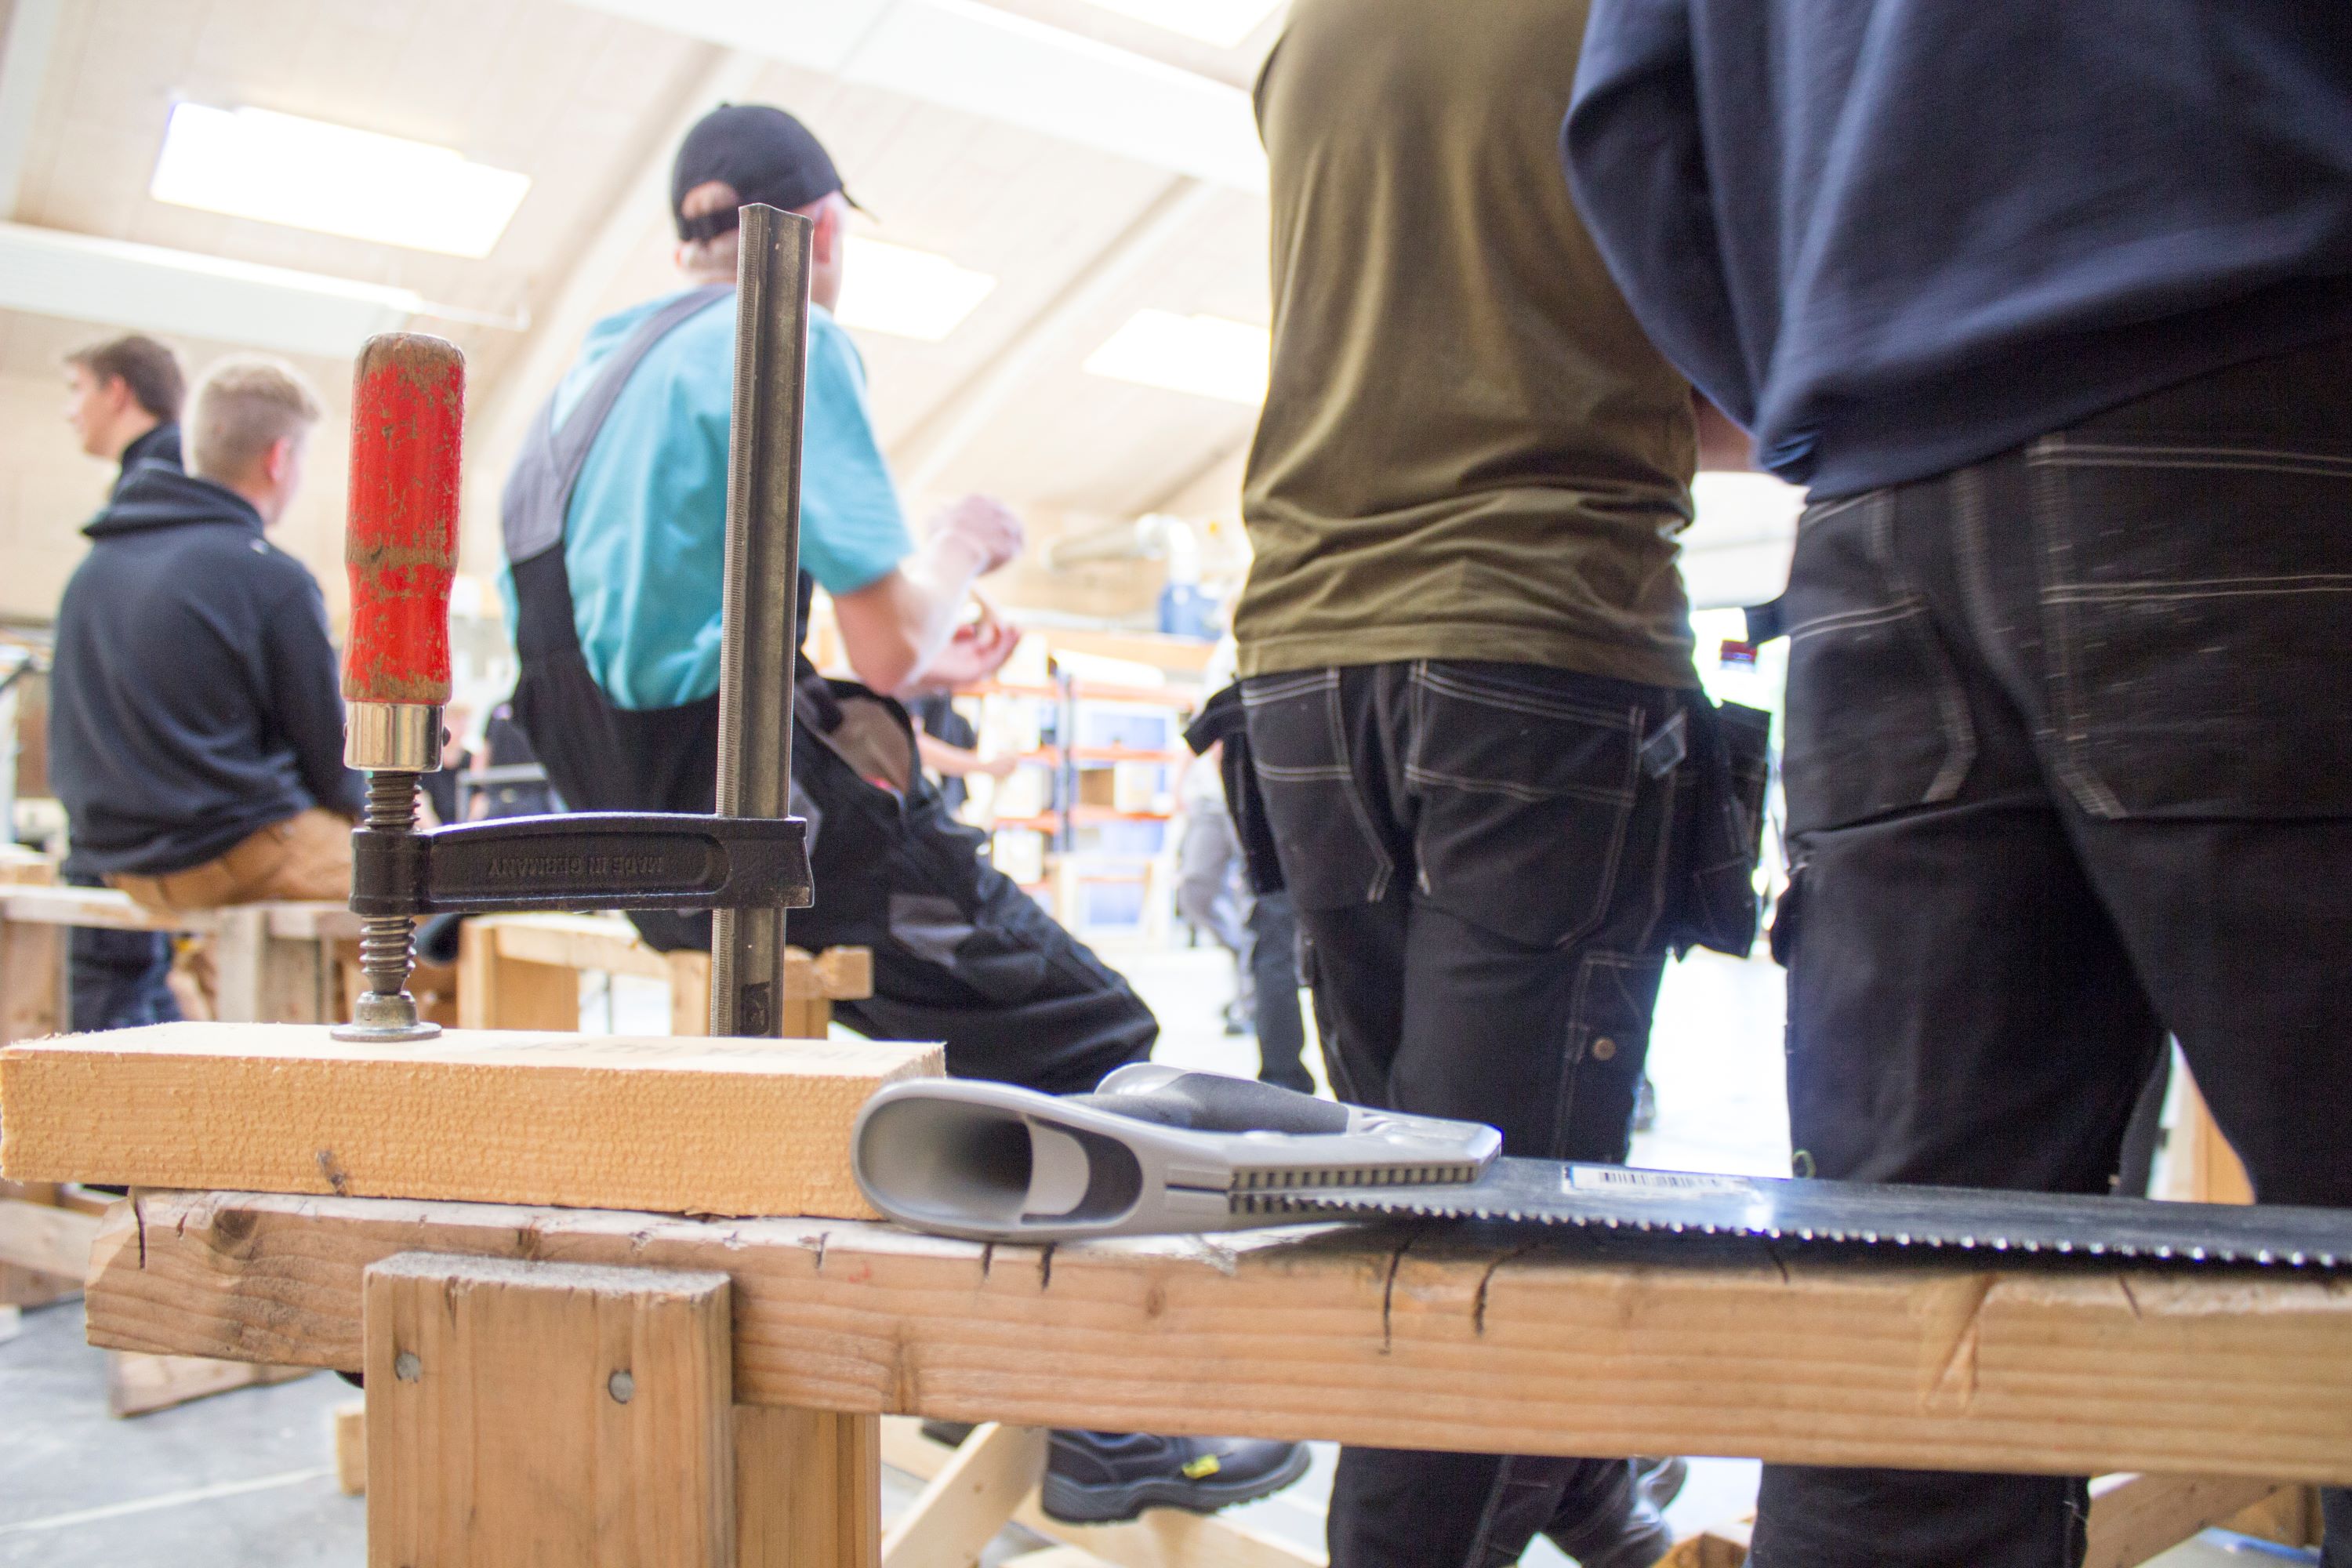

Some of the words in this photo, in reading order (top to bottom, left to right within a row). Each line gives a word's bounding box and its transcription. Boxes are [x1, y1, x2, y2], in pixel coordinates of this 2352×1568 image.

[488, 857, 584, 877] GERMANY
[589, 857, 607, 874] IN
[612, 855, 664, 874] MADE
